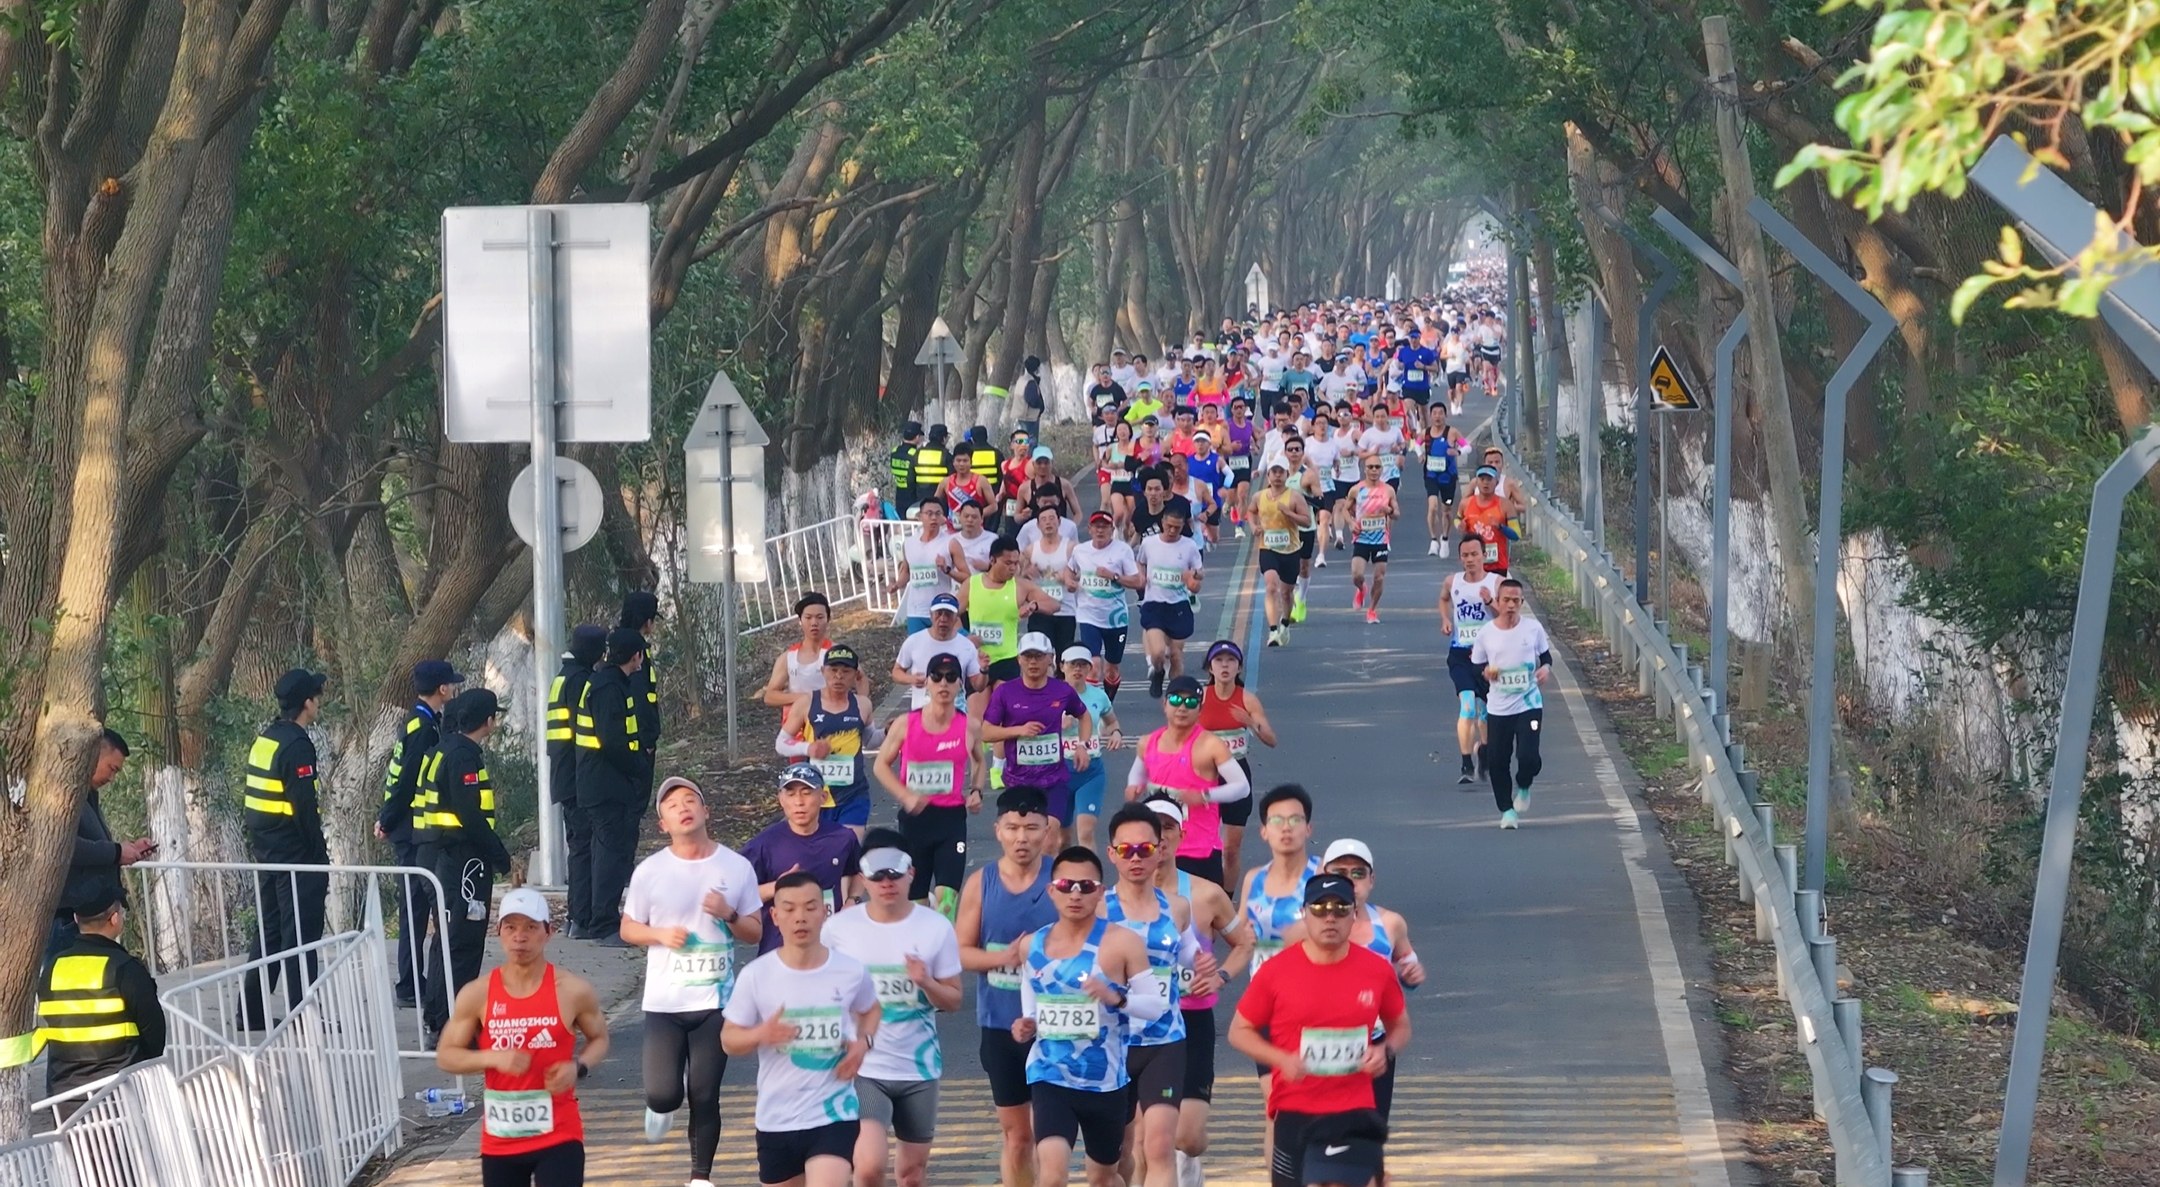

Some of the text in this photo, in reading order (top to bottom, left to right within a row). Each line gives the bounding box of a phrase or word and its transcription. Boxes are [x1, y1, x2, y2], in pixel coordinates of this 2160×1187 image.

[1265, 535, 1289, 543] A1850
[1082, 577, 1109, 587] A1582
[1153, 572, 1180, 582] A1330
[1457, 599, 1486, 621] 南昌
[1460, 629, 1480, 639] A16
[1501, 674, 1527, 685] 1161
[1019, 742, 1058, 757] A1815
[1062, 738, 1099, 751] A526
[820, 764, 852, 777] 1271
[908, 771, 951, 785] A1228
[673, 956, 726, 973] A1718
[880, 979, 914, 996] 280
[488, 1016, 558, 1029] GUANGZHOU
[1038, 1009, 1096, 1027] A2782
[793, 1022, 840, 1041] 2216
[490, 1034, 526, 1051] 2019
[528, 1041, 557, 1049] adidas
[488, 1105, 550, 1123] A1602
